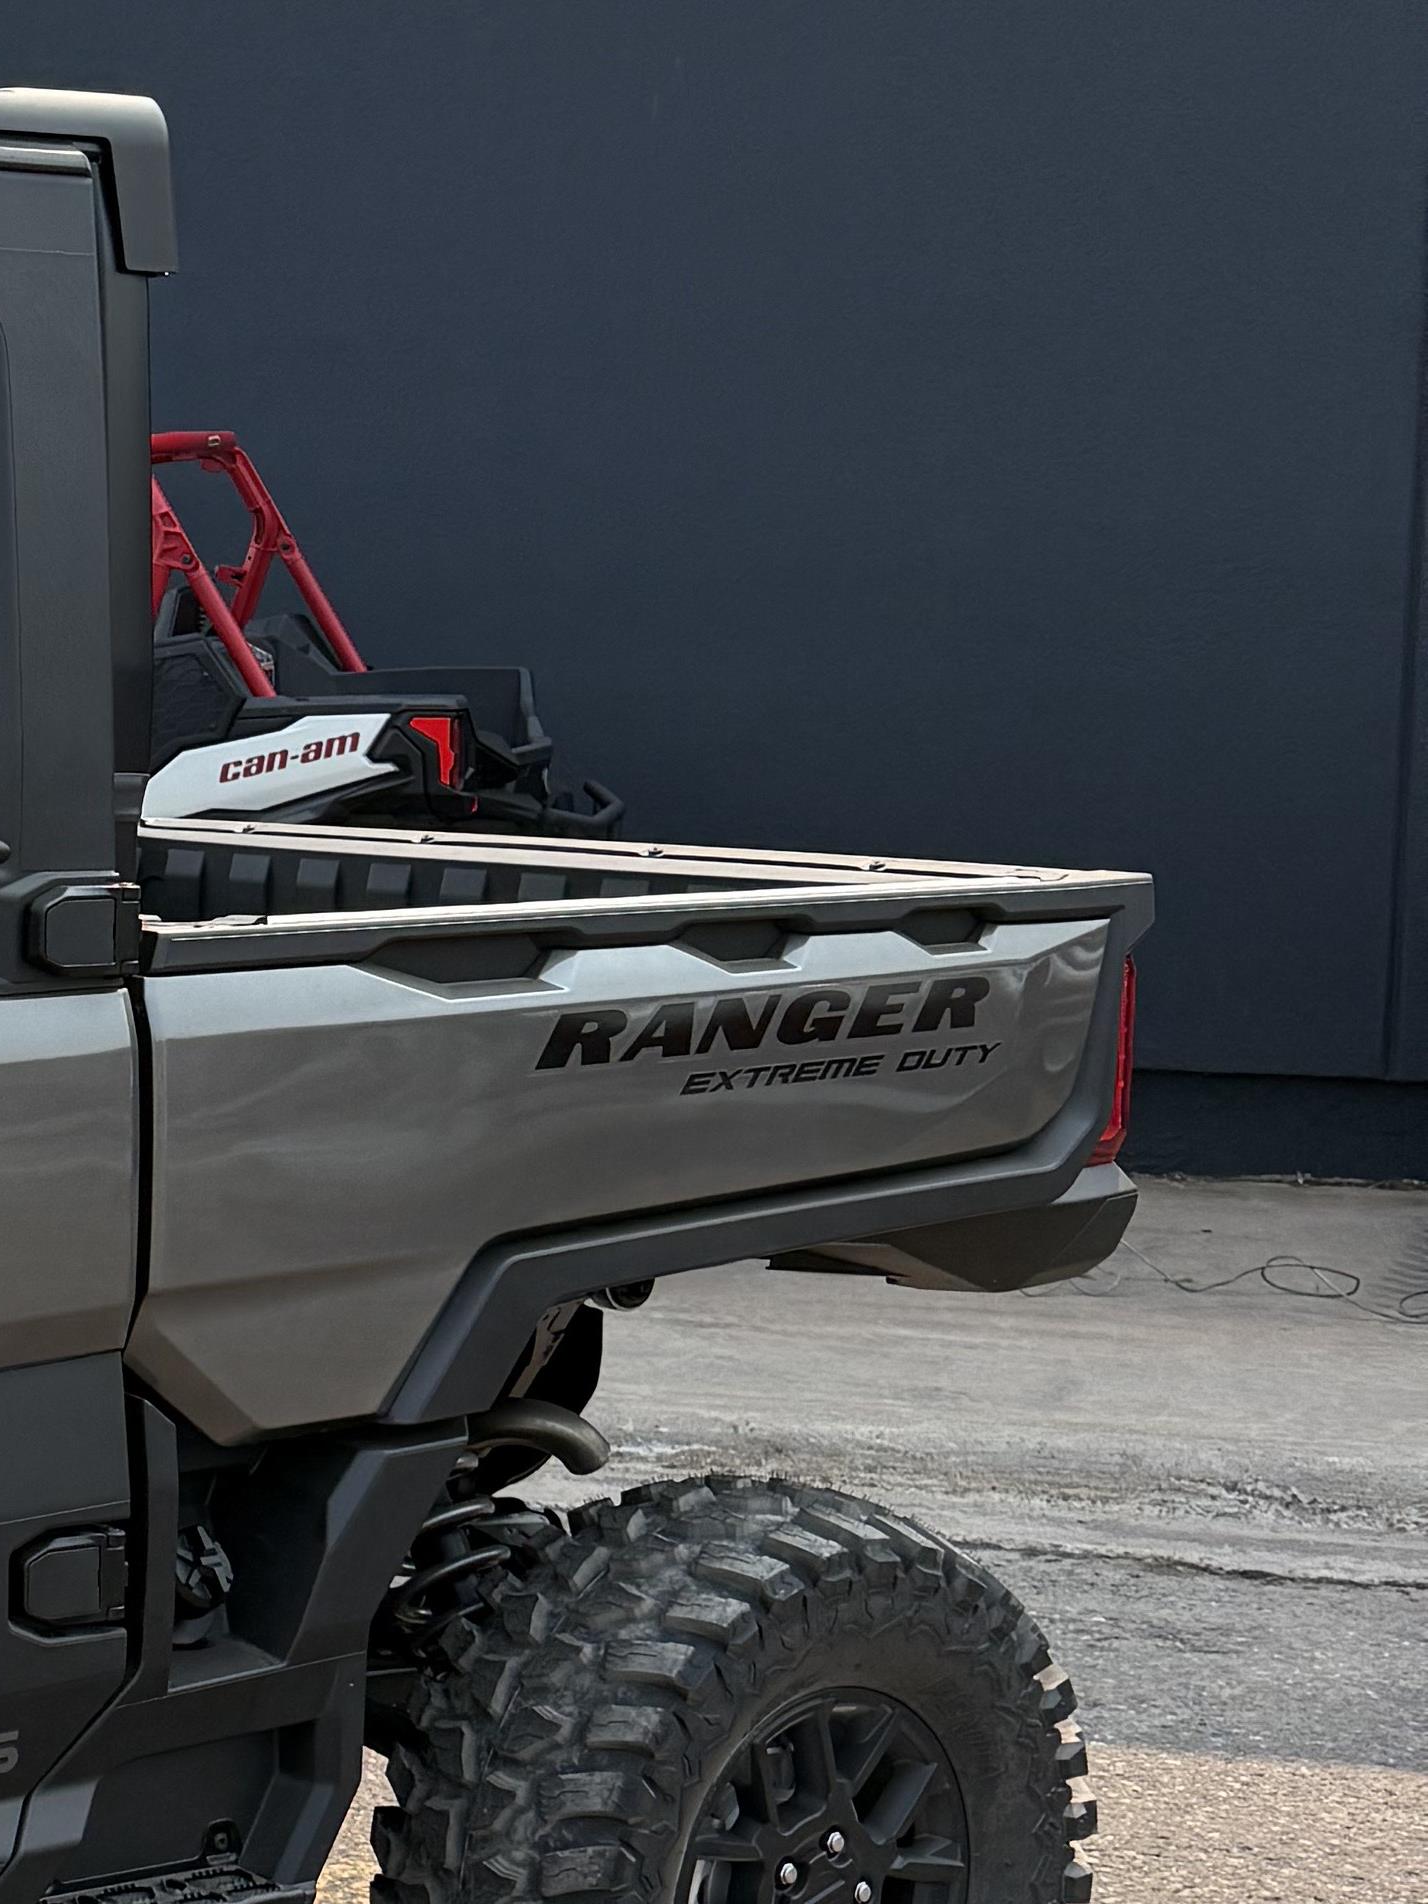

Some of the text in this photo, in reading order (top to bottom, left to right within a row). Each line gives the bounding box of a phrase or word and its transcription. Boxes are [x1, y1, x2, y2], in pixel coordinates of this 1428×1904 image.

[218, 731, 361, 784] can-am
[534, 976, 993, 1071] RANGER
[679, 1041, 1005, 1096] EXTREME DUTY
